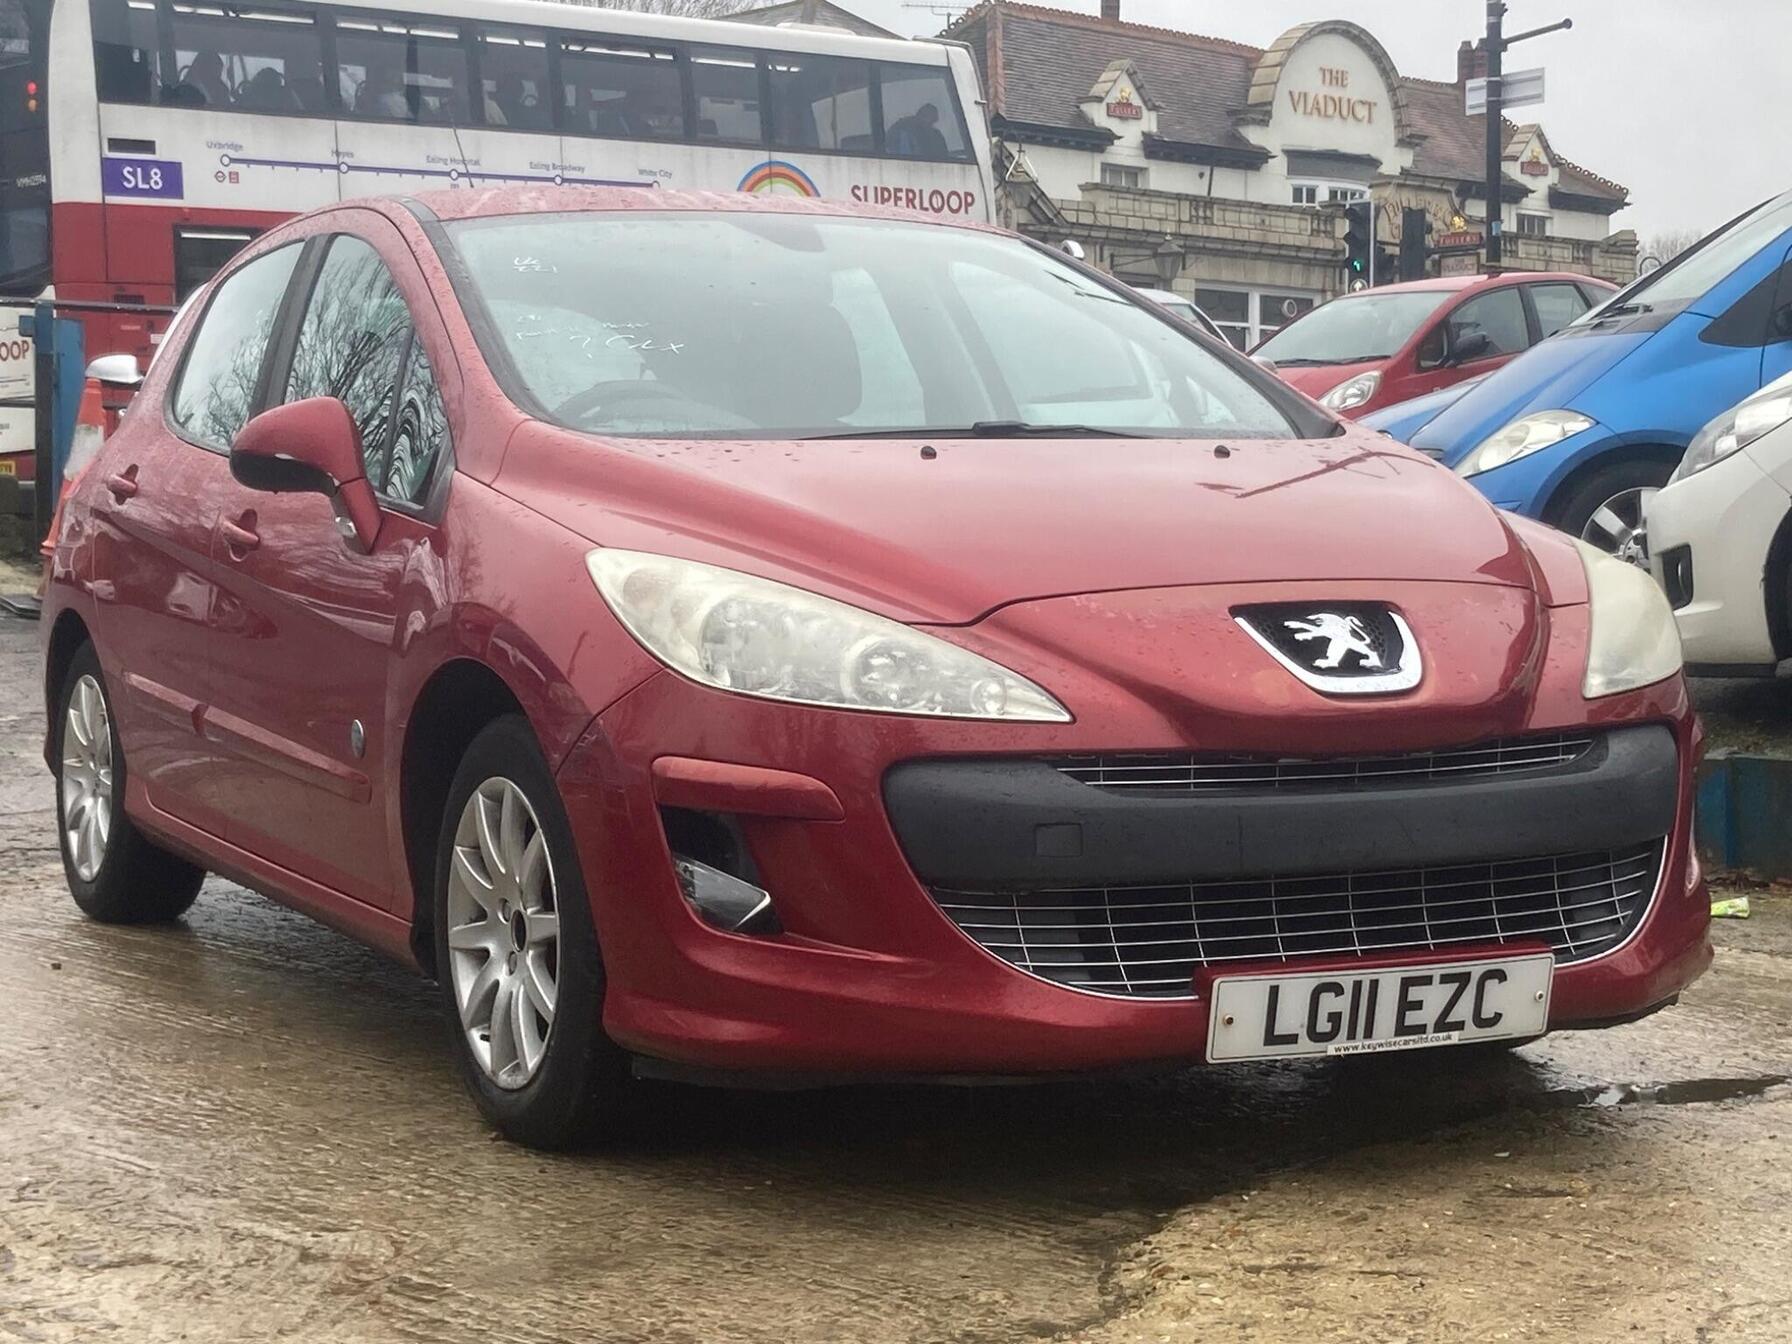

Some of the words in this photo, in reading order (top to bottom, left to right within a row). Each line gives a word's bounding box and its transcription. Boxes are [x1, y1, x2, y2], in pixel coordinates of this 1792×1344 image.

[1319, 66, 1349, 88] THE
[1288, 90, 1378, 124] VIADUCT
[122, 166, 163, 190] SL8
[850, 184, 976, 215] SUPERLOOP
[1263, 979, 1379, 1045] LG11
[1394, 969, 1507, 1036] EZC
[1334, 1033, 1453, 1054] www.keywisecarsltd.co.uk
